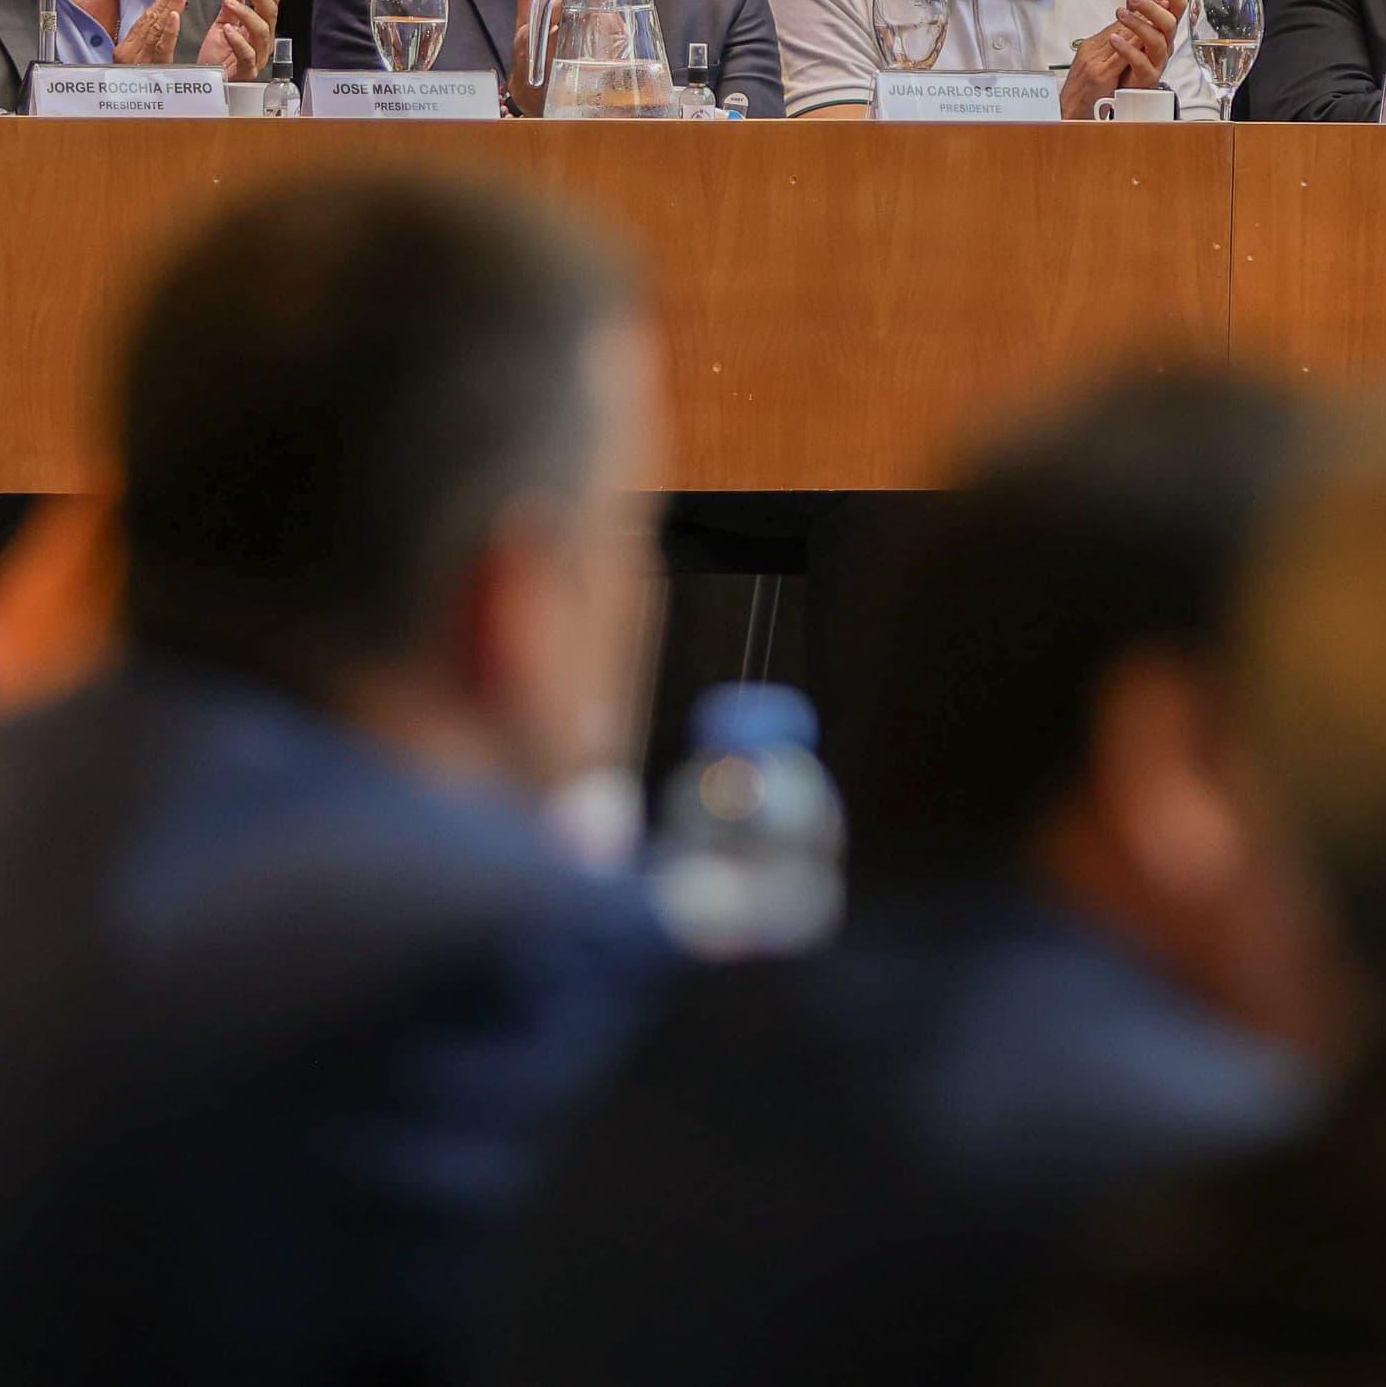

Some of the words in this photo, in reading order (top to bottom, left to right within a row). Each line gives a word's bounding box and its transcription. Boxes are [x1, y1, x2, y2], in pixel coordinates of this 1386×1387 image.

[46, 81, 95, 94] JORGE
[99, 81, 163, 94] ROCCHIA
[166, 81, 213, 94] FERRO
[332, 83, 369, 95] JOSE
[372, 83, 416, 95] MARIA
[419, 83, 477, 95] CANTOS
[888, 84, 924, 97] JUAN
[927, 85, 982, 98] CARLOS
[985, 86, 1050, 99] SERRANO
[98, 100, 165, 110] PRESIDENTE
[374, 101, 439, 112] PRESIDENTE
[939, 102, 1002, 114] PRESIDENTE
